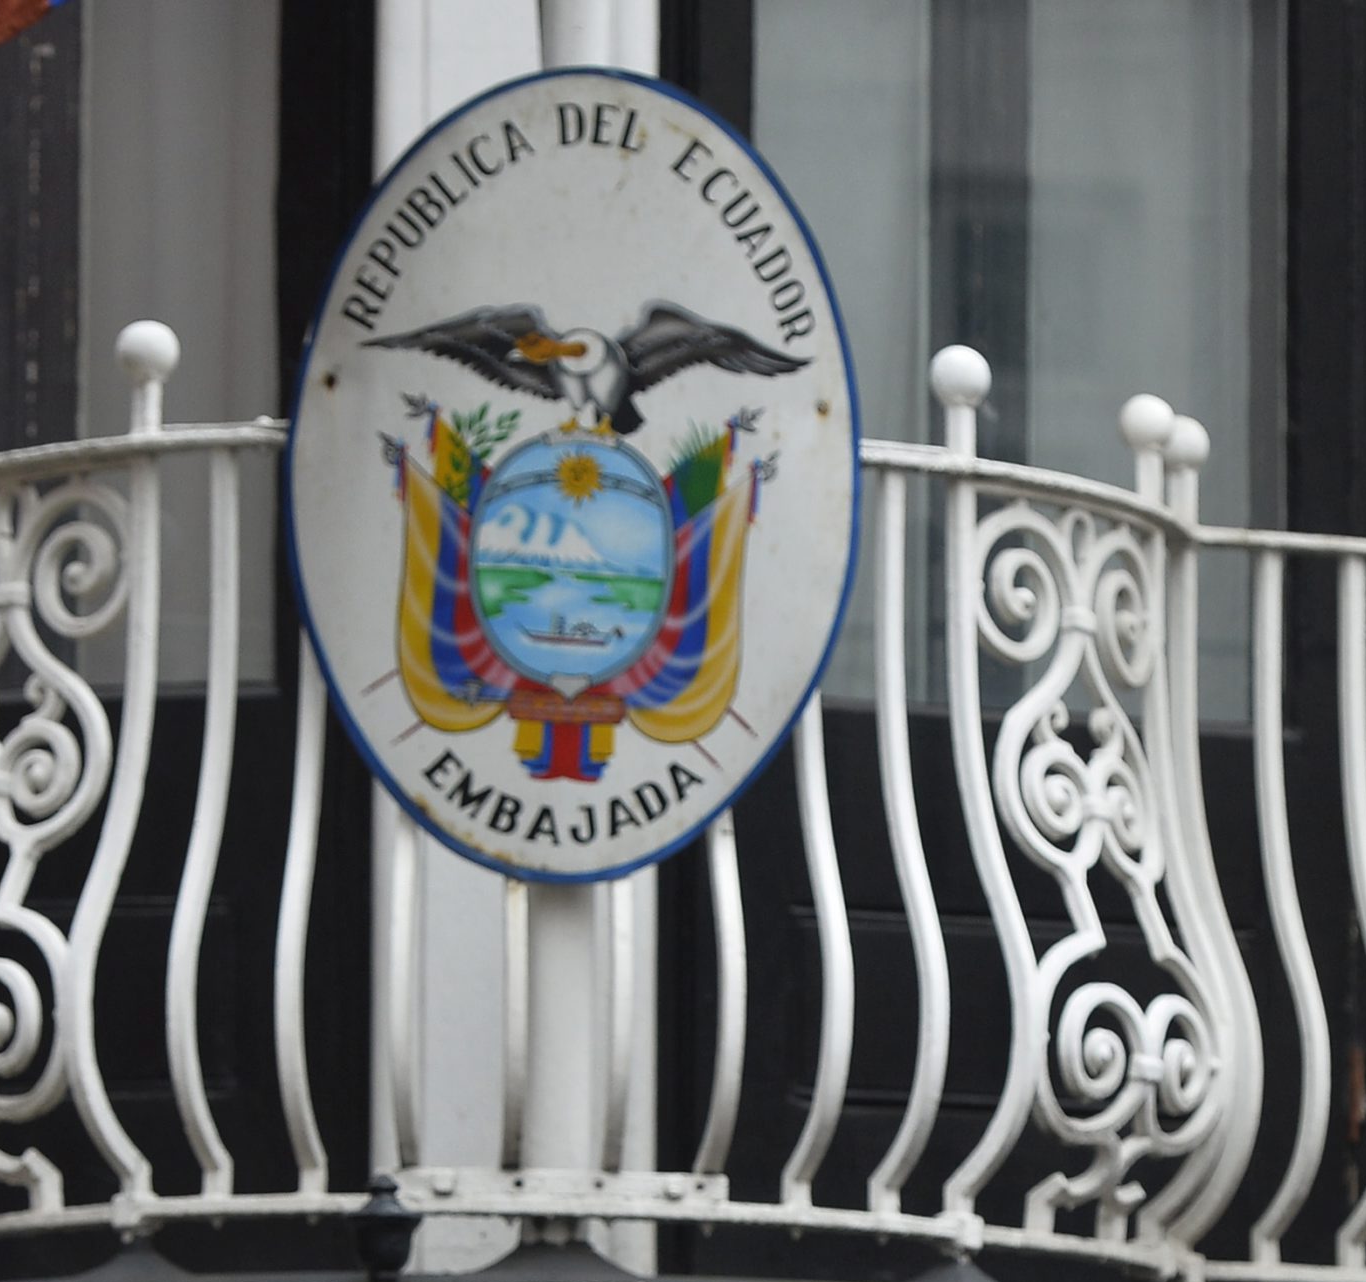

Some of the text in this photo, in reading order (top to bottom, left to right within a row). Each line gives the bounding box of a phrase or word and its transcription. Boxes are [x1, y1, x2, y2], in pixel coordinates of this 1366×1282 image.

[341, 101, 816, 346] REPUBLICA DEL ECUADOR
[421, 750, 704, 846] EMBAJADA
